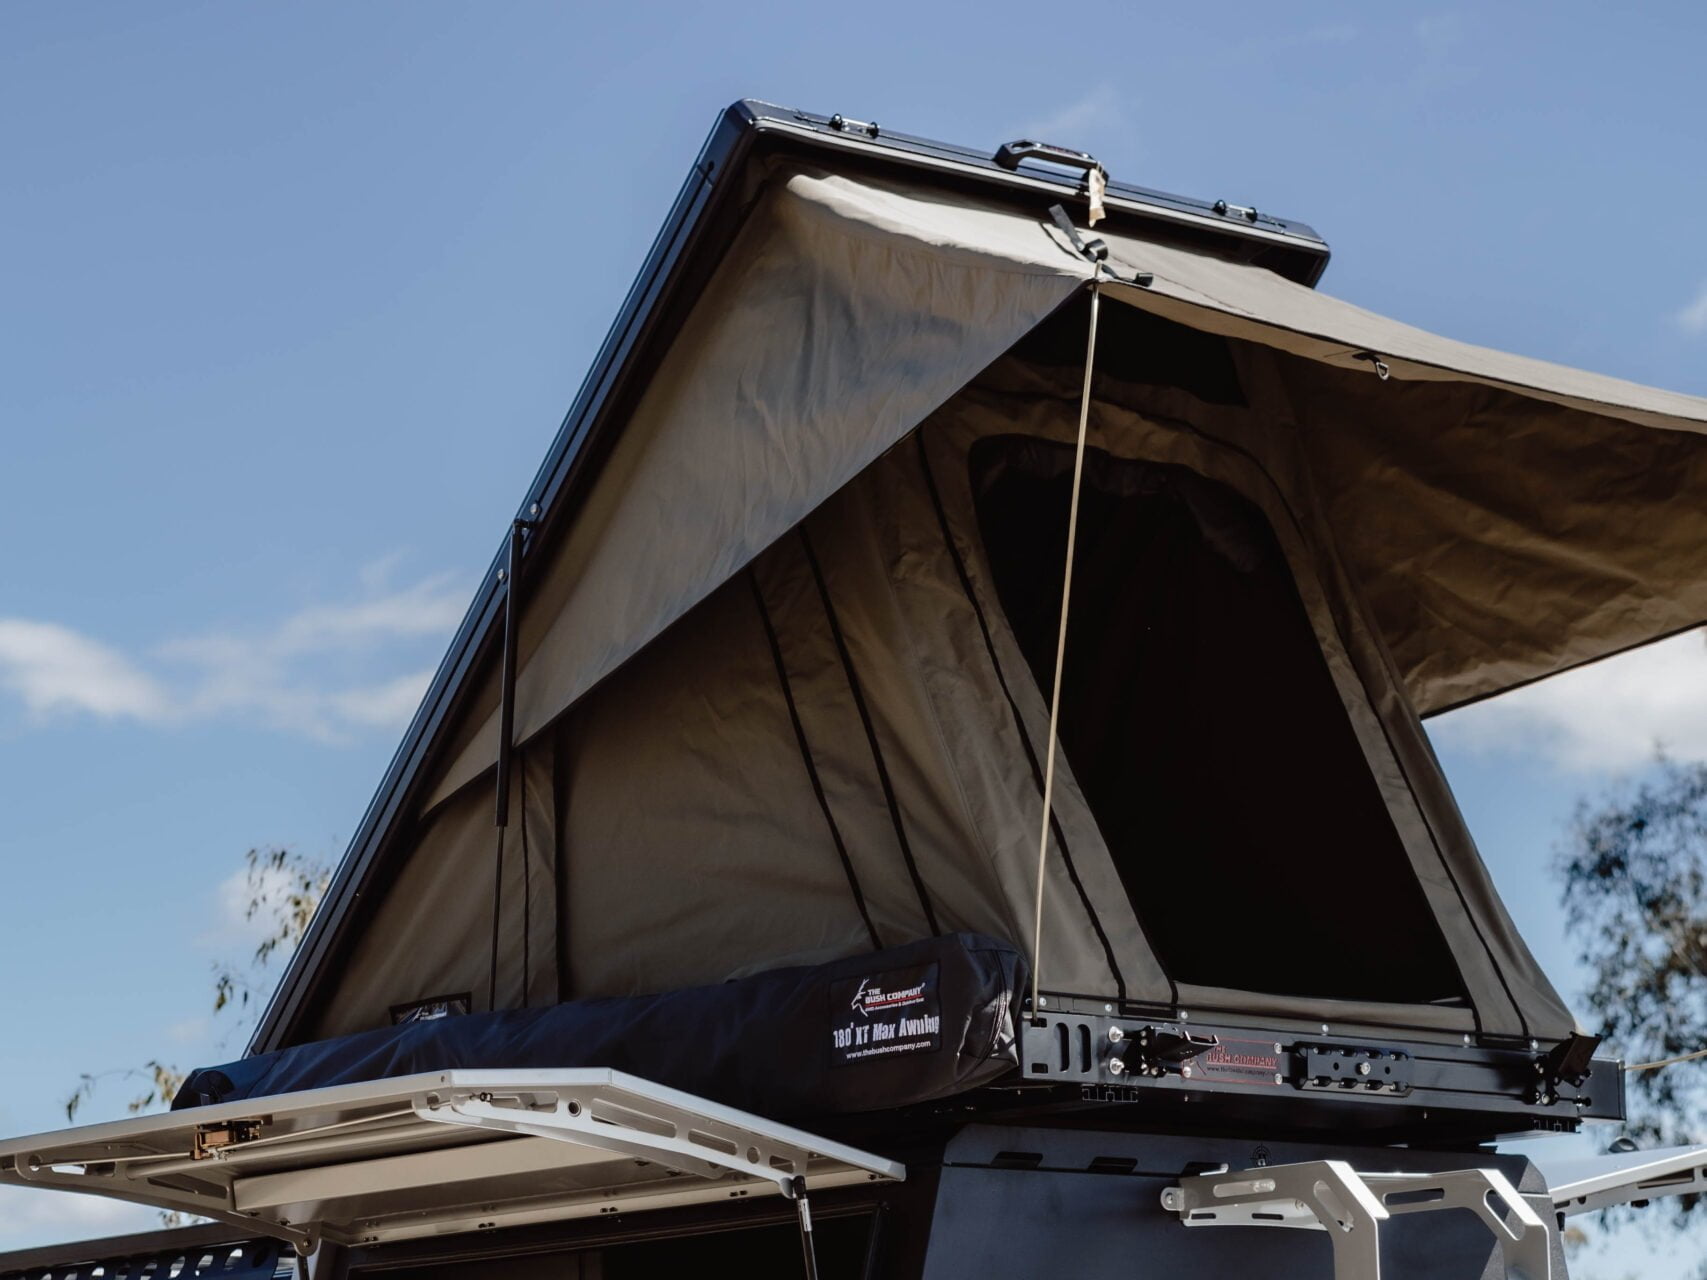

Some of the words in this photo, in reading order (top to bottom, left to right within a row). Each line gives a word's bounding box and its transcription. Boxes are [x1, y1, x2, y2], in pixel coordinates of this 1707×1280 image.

[865, 994, 886, 1004] BUSH
[887, 985, 924, 1001] COMPANY
[868, 988, 881, 996] THE
[856, 1024, 870, 1045] XT
[873, 1022, 896, 1041] Max
[899, 1014, 940, 1037] Awning
[846, 1040, 931, 1059] www.thebushcompany.com
[1234, 1054, 1279, 1067] COMPANY
